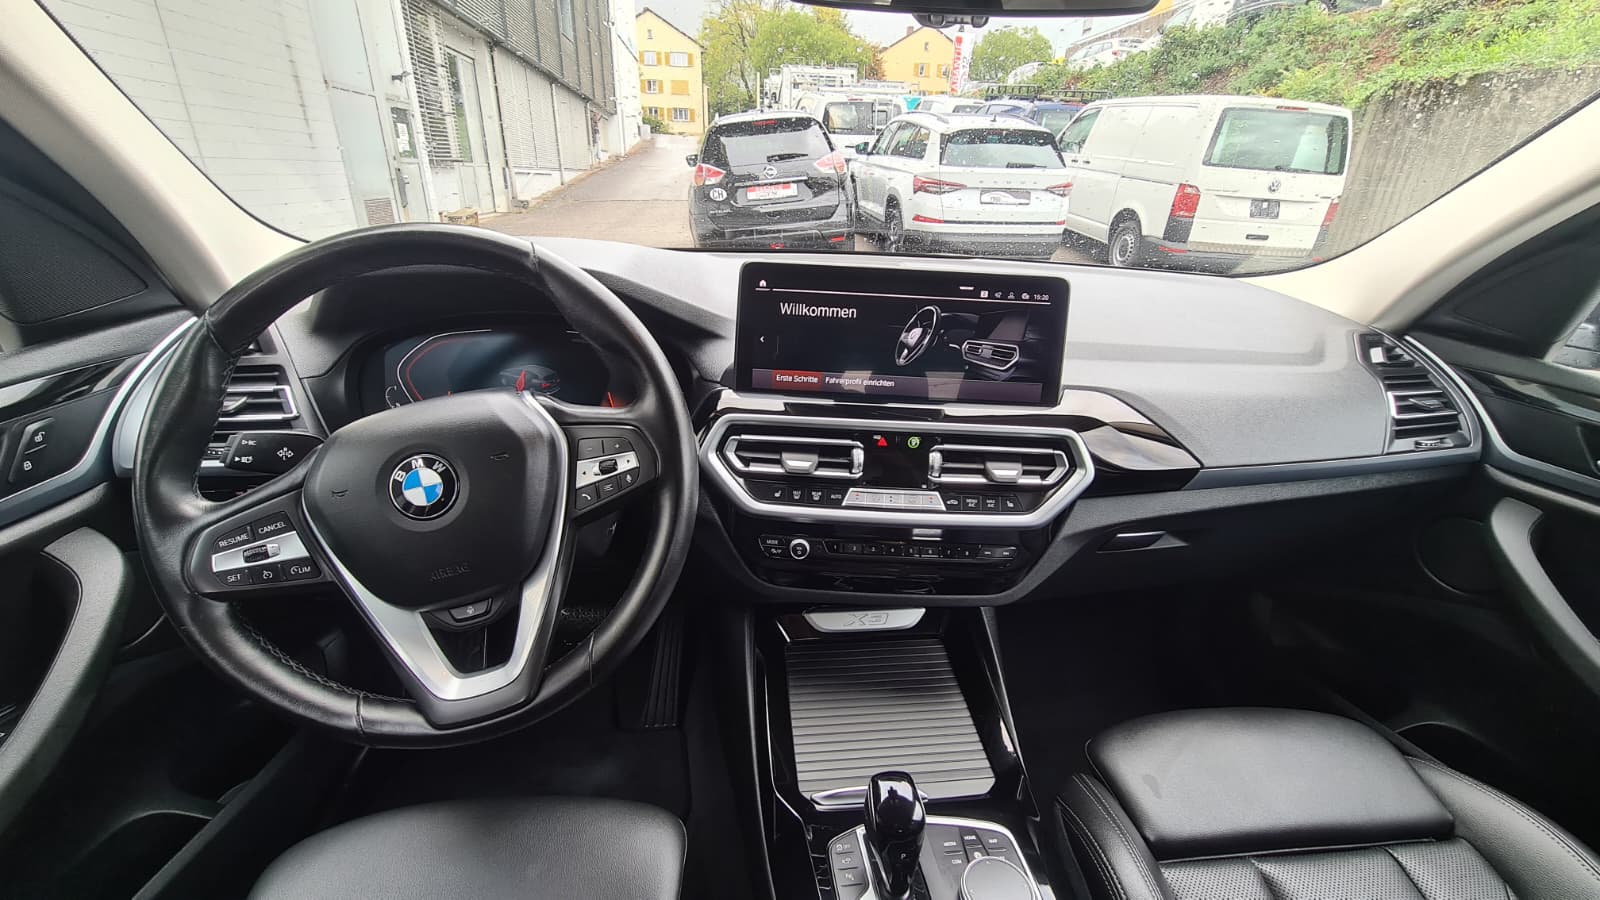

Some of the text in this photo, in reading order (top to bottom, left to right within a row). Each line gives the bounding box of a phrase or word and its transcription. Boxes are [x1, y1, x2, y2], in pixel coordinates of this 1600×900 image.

[780, 302, 857, 318] Willkommen
[825, 377, 895, 387] Fahrerprofil einrichten
[394, 458, 446, 482] BMW
[258, 521, 286, 534] CANCEL
[218, 532, 248, 547] RESUME
[227, 573, 241, 582] SET
[843, 612, 889, 627] X3
